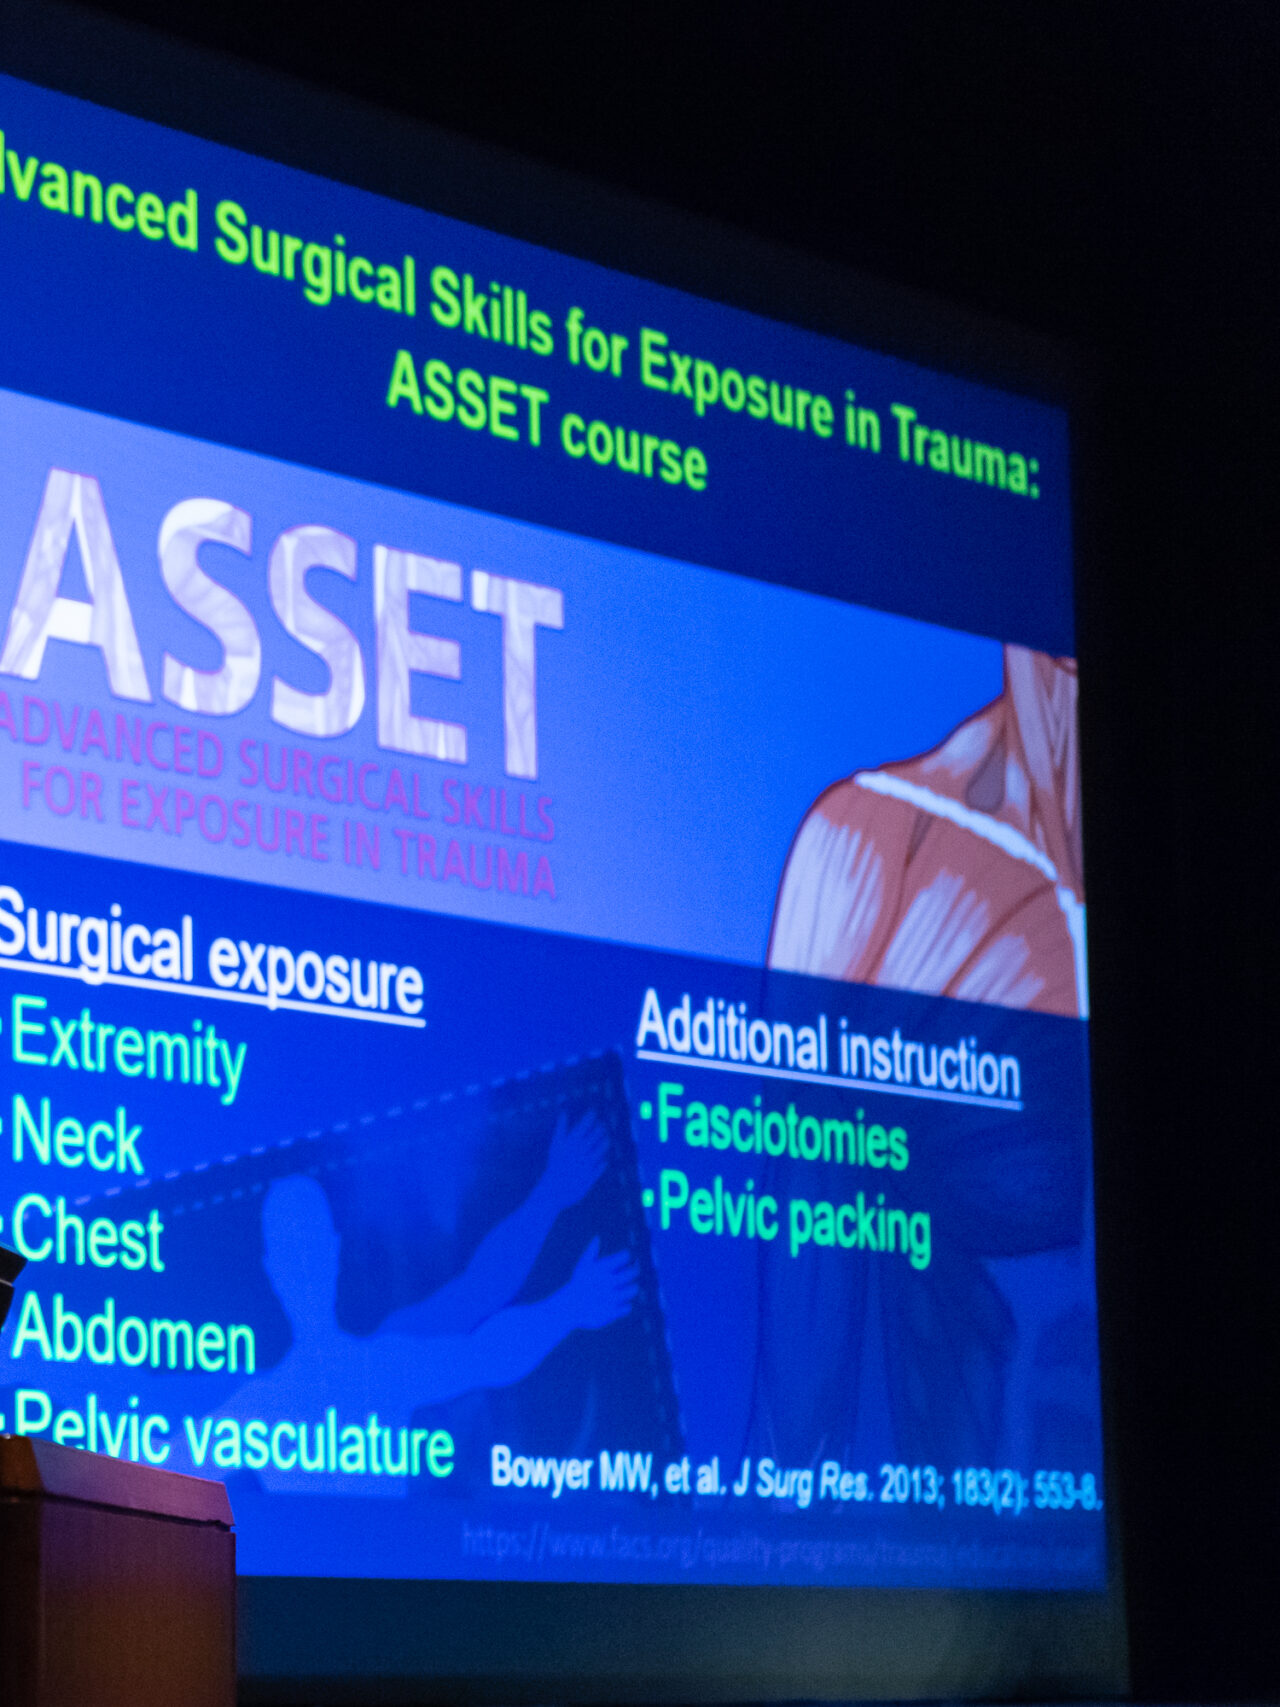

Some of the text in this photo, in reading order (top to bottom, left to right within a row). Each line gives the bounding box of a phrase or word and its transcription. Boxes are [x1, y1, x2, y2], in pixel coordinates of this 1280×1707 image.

[215, 200, 416, 316] Surgical
[431, 266, 553, 355] Skills
[567, 307, 628, 376] for
[640, 328, 833, 438] Exposure
[844, 389, 880, 452] in
[891, 403, 1039, 499] Trauma:
[387, 350, 708, 491] ASSET course
[23, 761, 557, 901] FOR EXPOSURE IN TRAUMA
[239, 739, 431, 820] SURGICAL
[443, 778, 556, 842] SKILLS
[208, 937, 424, 1015] exposure
[13, 994, 247, 1106] Extremity
[637, 988, 1020, 1098] Additional instruction
[13, 1094, 144, 1175] Neck
[658, 1082, 909, 1171] Fasciotomies
[12, 1193, 165, 1273] Chest
[660, 1169, 931, 1270] Pelvic packing
[11, 1291, 256, 1374] Abdomen
[15, 1388, 455, 1478] Pelvic vasculature
[491, 1444, 1103, 1516] Bowyer MW, et al. J Surg Res. 2013; 183(2): 553-8.
